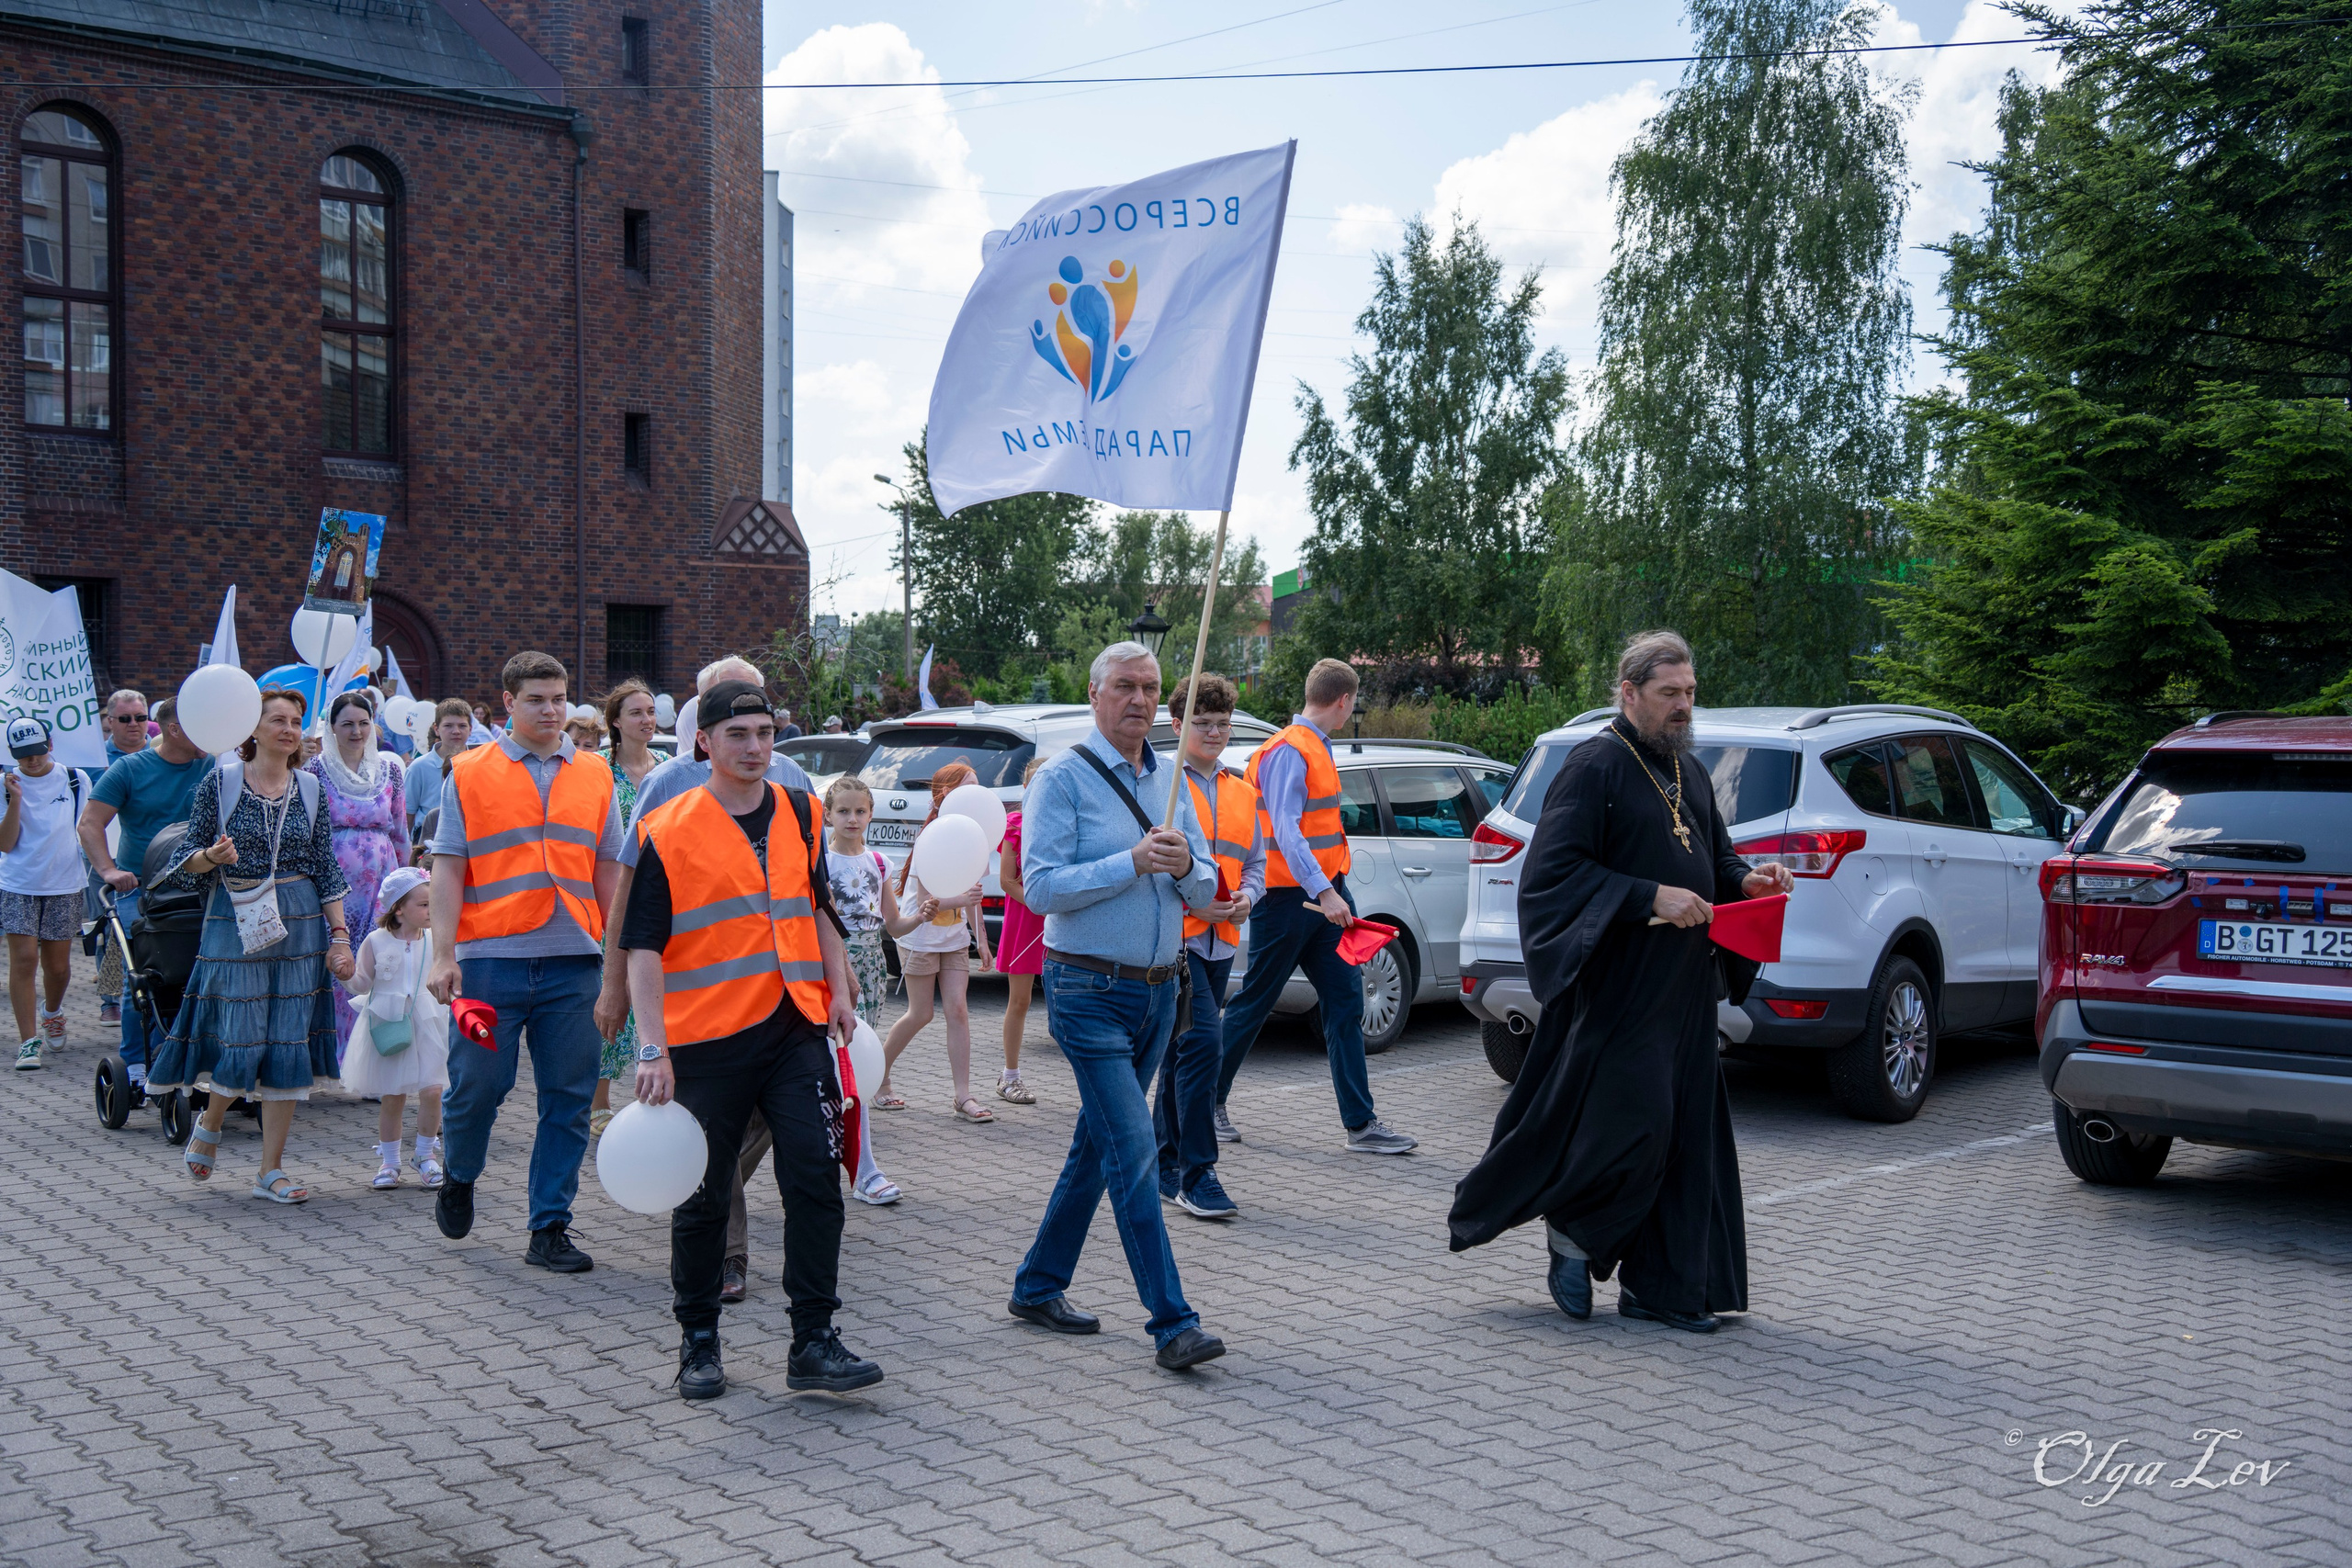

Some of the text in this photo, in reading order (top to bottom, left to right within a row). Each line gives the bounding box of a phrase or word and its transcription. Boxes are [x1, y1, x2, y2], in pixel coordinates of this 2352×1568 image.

[891, 799, 905, 808] KIA
[2217, 925, 2235, 951] B
[2256, 927, 2295, 953] GT
[2301, 930, 2352, 957] 125
[2079, 953, 2125, 965] RAV4
[2231, 954, 2267, 963] AUTOMOBILE
